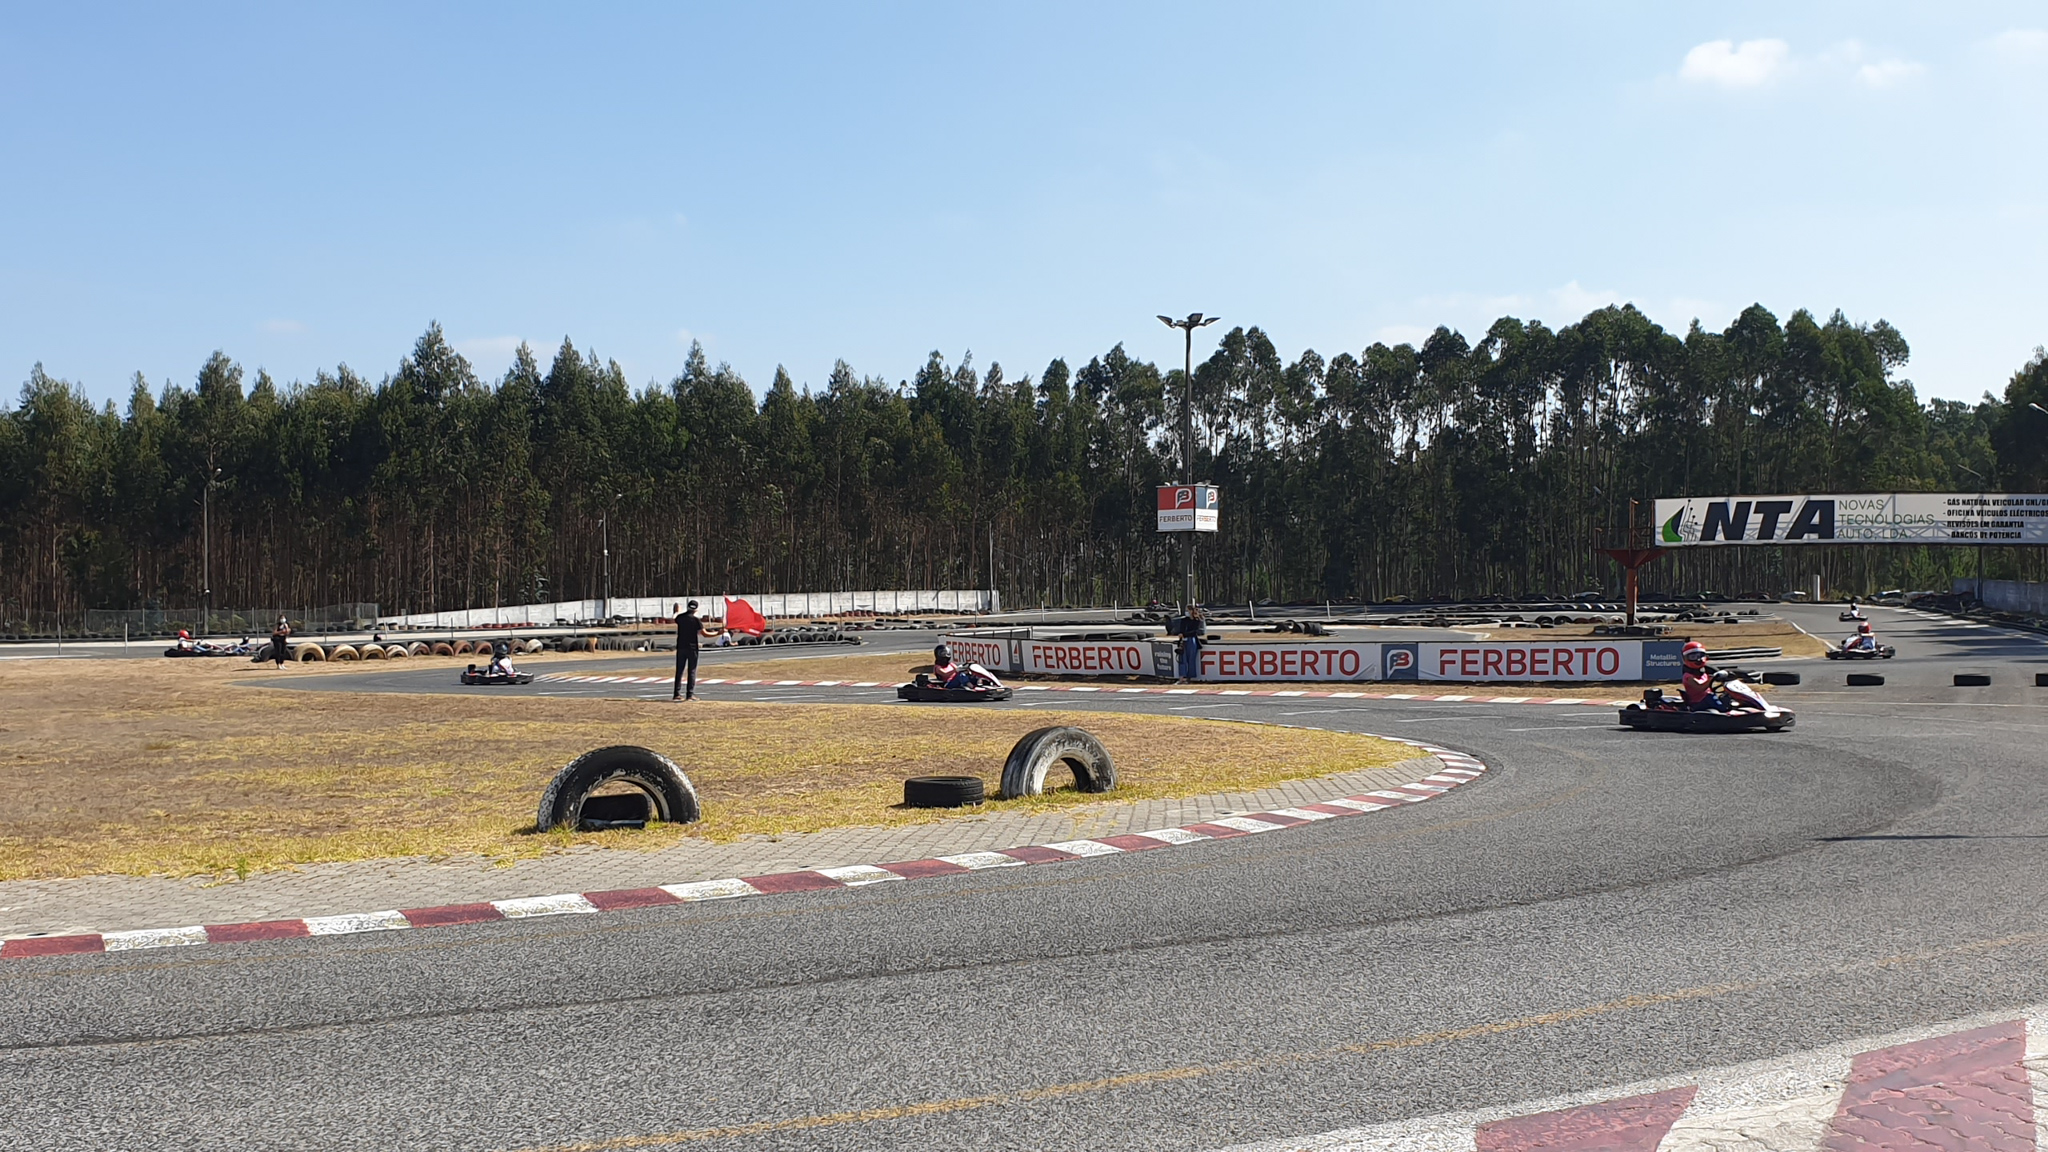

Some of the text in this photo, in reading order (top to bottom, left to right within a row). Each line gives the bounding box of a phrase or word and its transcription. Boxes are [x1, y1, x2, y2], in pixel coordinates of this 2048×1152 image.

[1838, 499, 1884, 511] NOVAS
[1962, 498, 1990, 506] NATURAL
[1992, 498, 2024, 506] VEICULAR
[1159, 515, 1193, 523] FERBERTO
[1838, 513, 1935, 525] TECNOLOGIAS
[1946, 509, 1975, 517] OFICINA
[1700, 500, 1835, 541] NTA
[1032, 645, 1142, 671] FERBERTO
[1201, 650, 1360, 676] FERBERTO
[1439, 647, 1620, 676] FERBERTO
